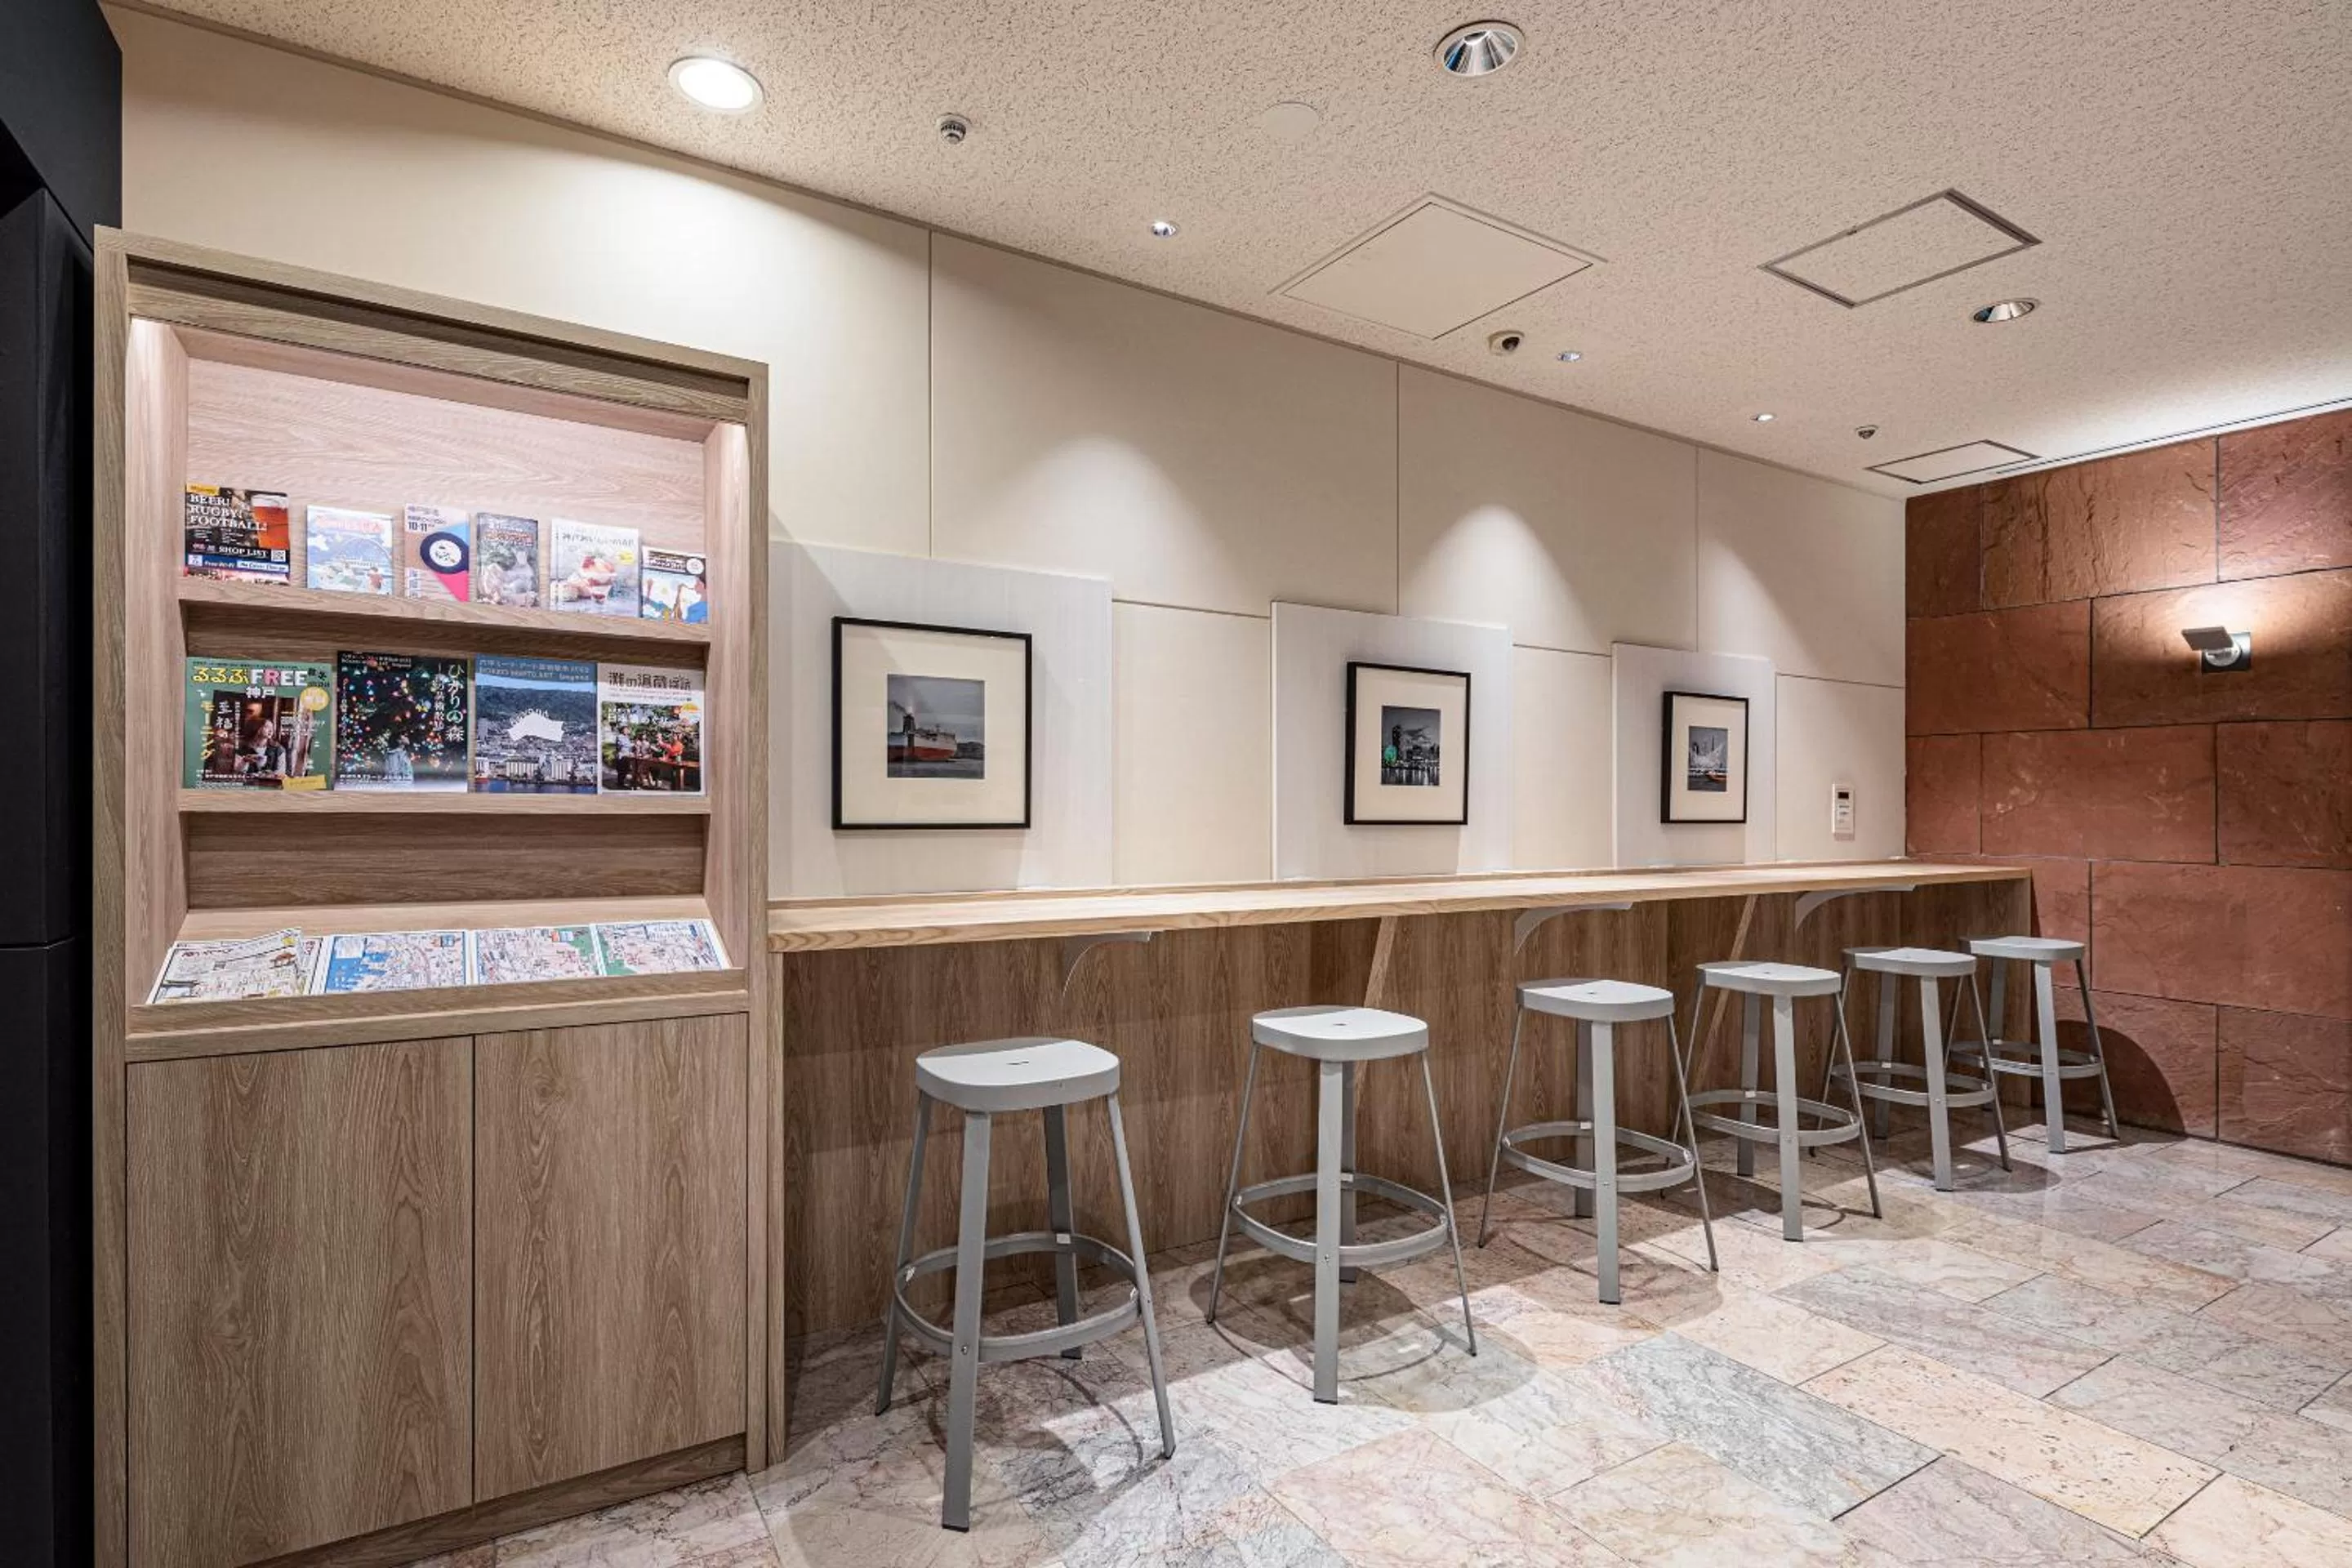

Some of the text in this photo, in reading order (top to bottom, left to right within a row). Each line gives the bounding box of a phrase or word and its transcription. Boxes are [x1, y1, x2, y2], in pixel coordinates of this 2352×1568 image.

[189, 493, 229, 506] BEER!
[189, 506, 243, 519] RUGBY!
[189, 514, 268, 531] FOOTBALL!
[218, 545, 245, 555] SHOP
[247, 548, 267, 557] LIST
[193, 666, 249, 684] るるぶ
[250, 669, 308, 687] FREE
[246, 686, 276, 699] 神戸
[445, 664, 465, 742] ひかりの森
